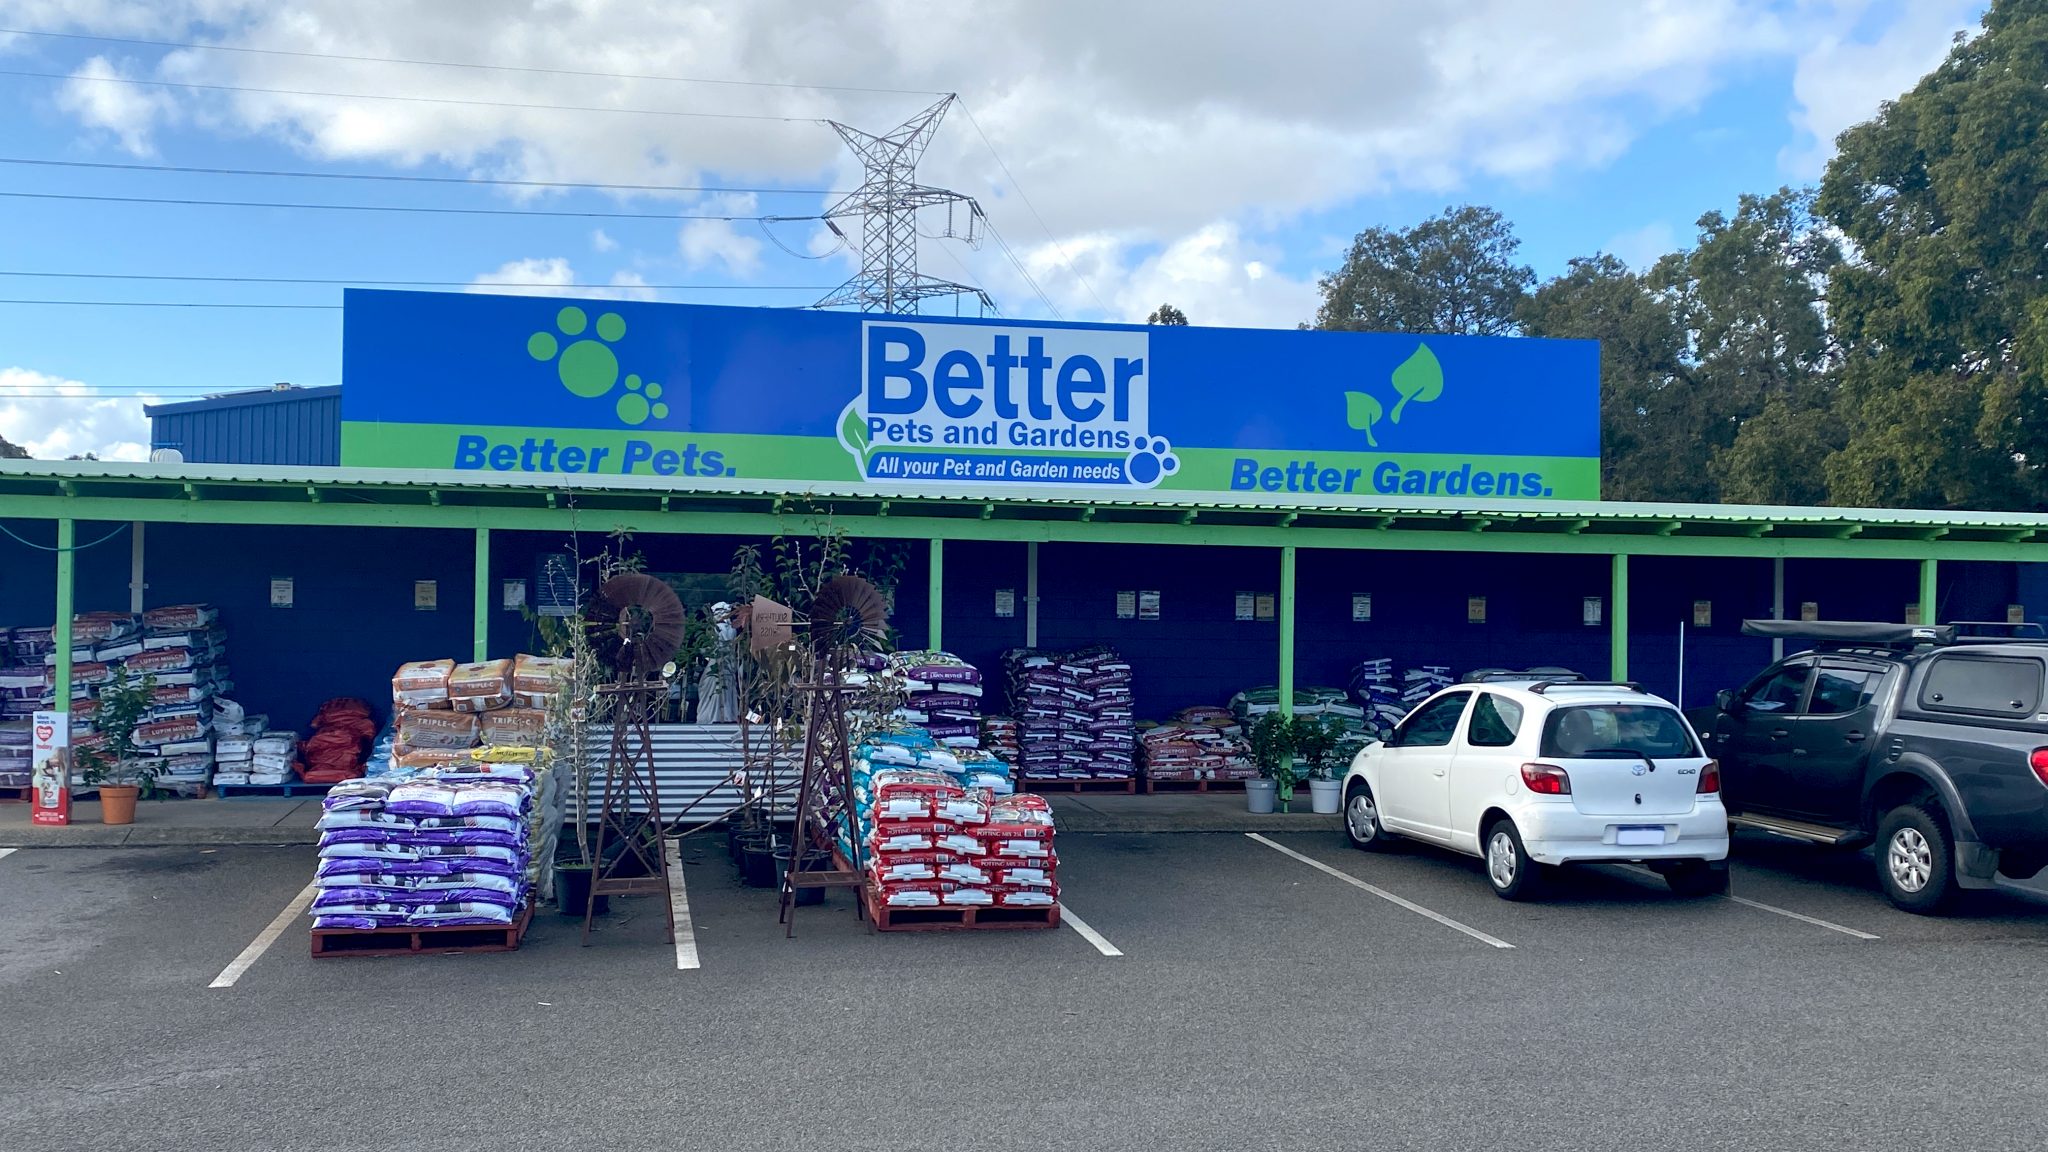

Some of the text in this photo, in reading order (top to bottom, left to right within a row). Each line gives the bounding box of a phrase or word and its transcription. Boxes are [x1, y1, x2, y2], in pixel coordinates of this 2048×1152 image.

[868, 326, 1143, 423] Better
[867, 417, 1130, 449] Pets and Gardens
[454, 435, 736, 477] Better Pets.
[876, 456, 1120, 480] All your Pet and Garden needs
[1230, 458, 1553, 496] Better Gardens.
[151, 728, 172, 736] LUPIN
[417, 718, 457, 728] TRIPLE-C
